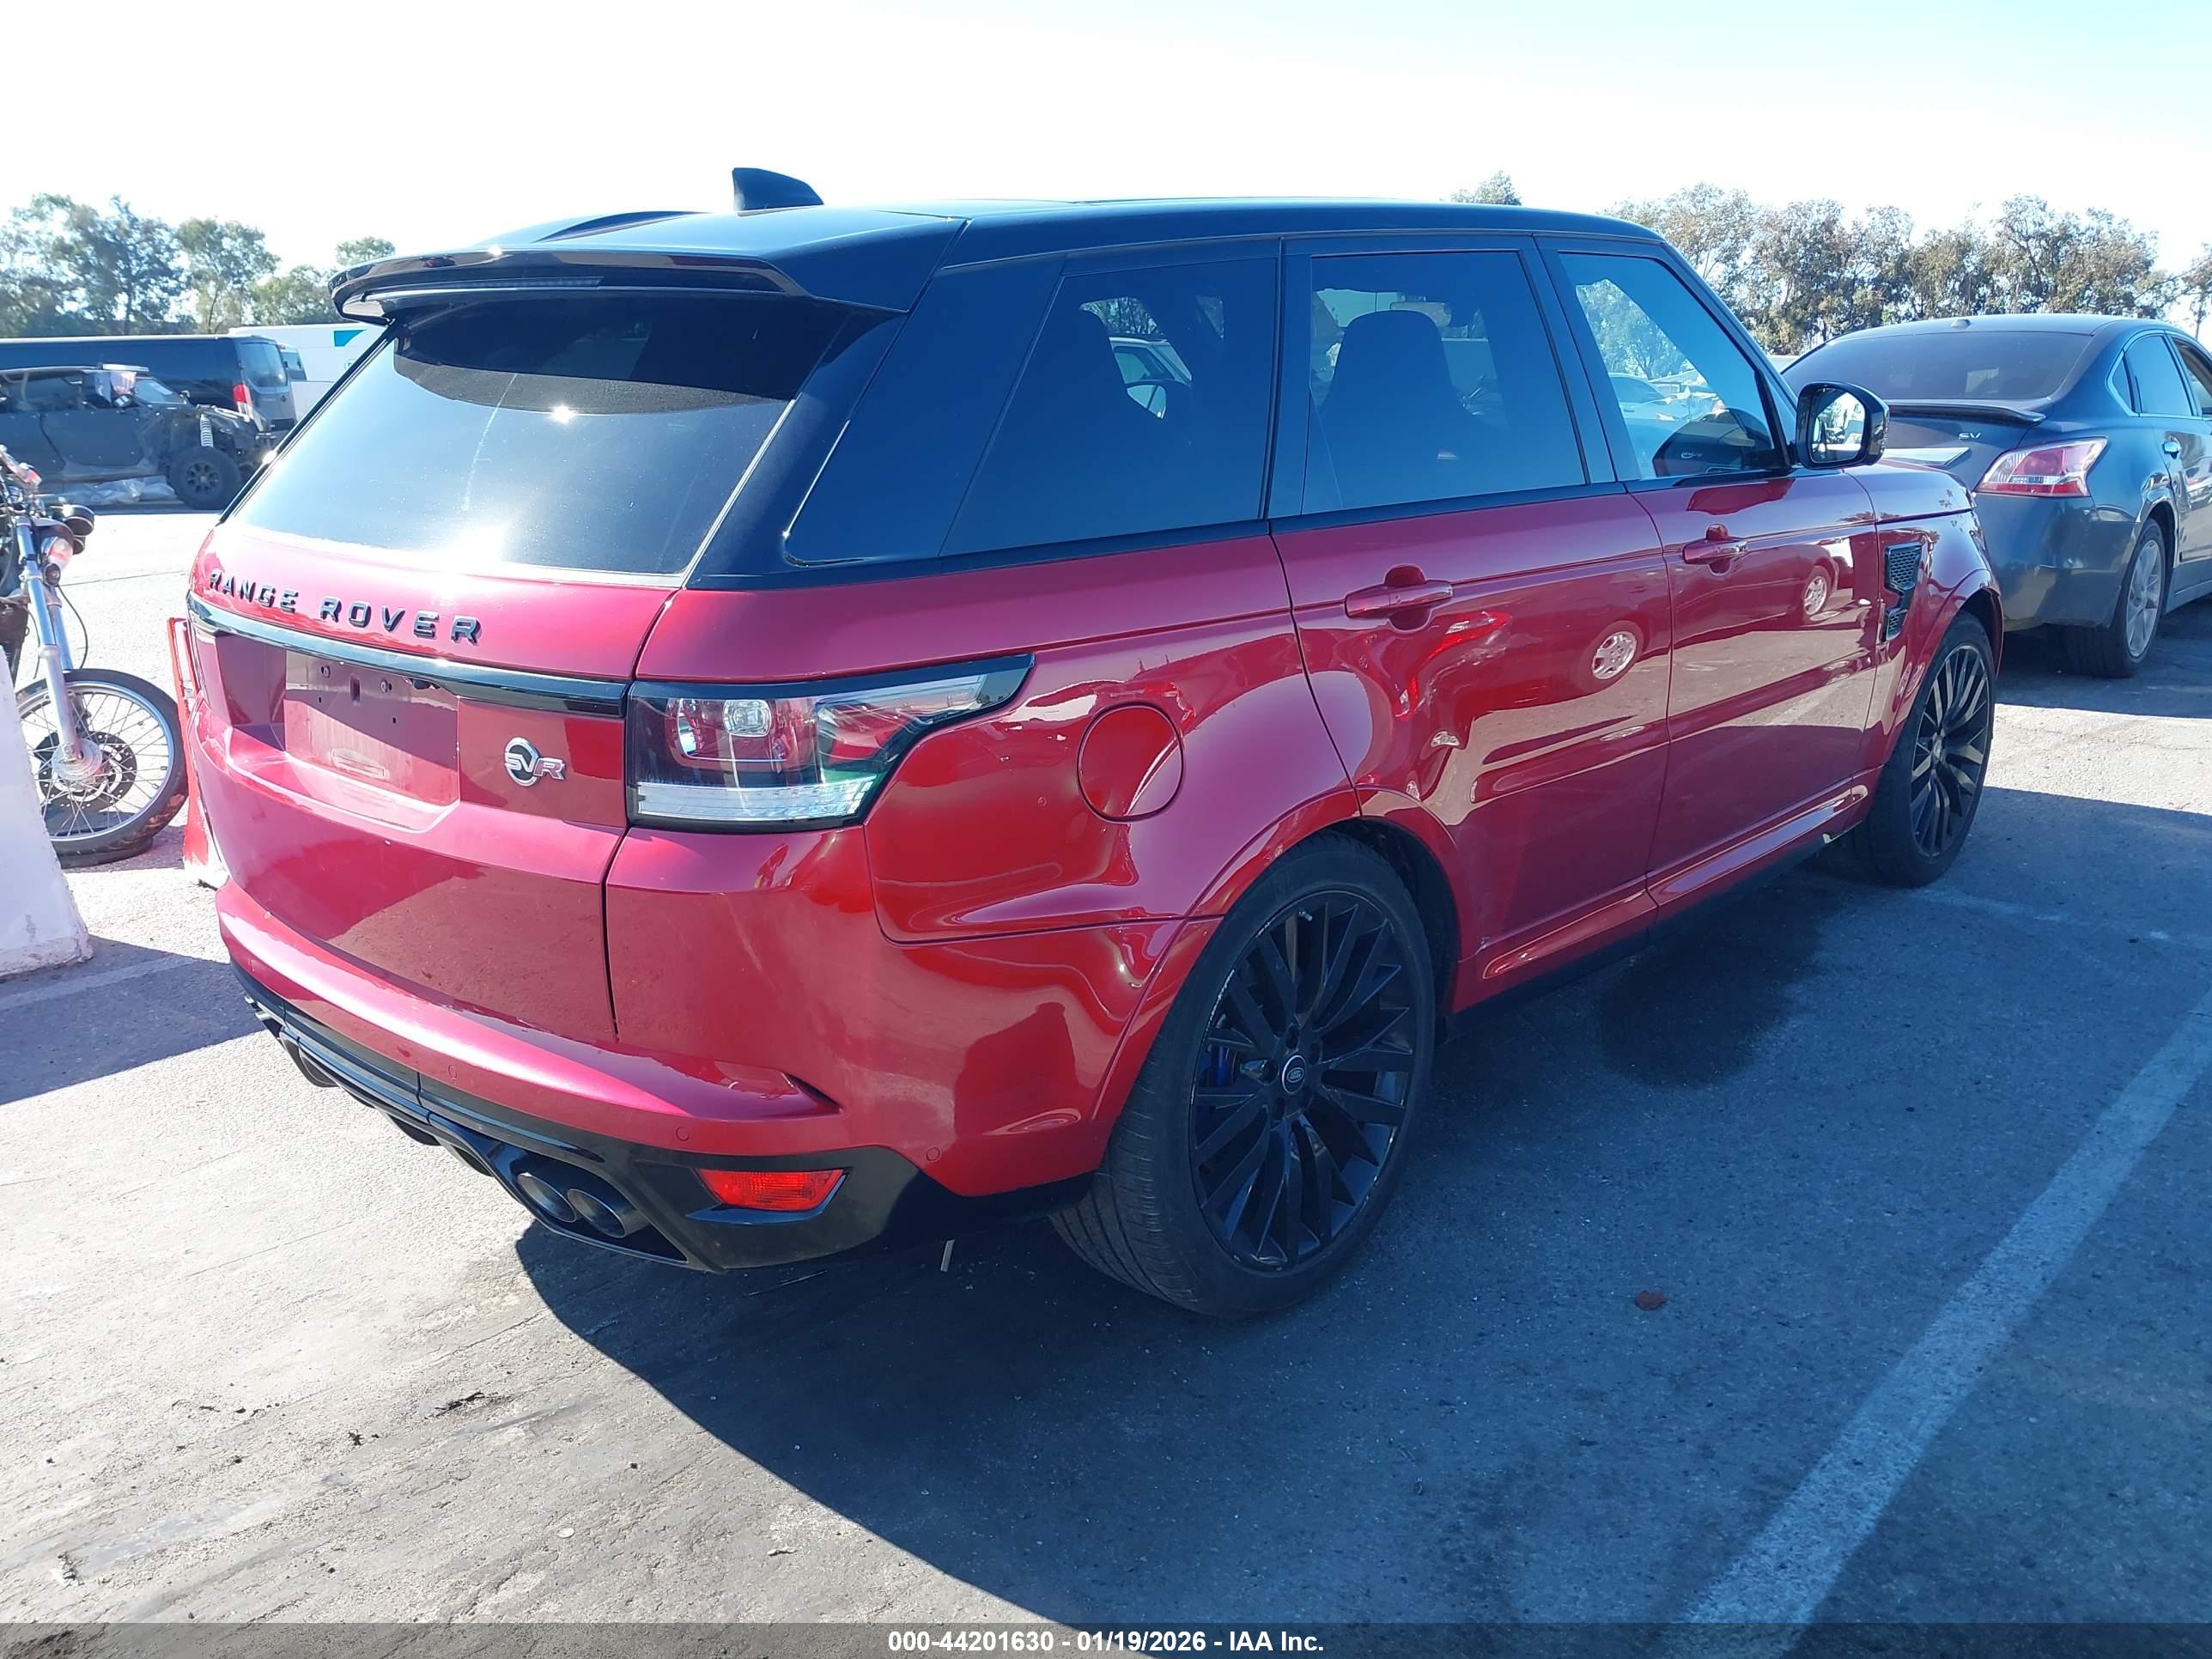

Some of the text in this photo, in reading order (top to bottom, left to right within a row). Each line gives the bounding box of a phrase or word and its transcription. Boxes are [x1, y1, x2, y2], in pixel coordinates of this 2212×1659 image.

[210, 568, 482, 645] RANGE ROVER
[504, 749, 566, 781] SVR
